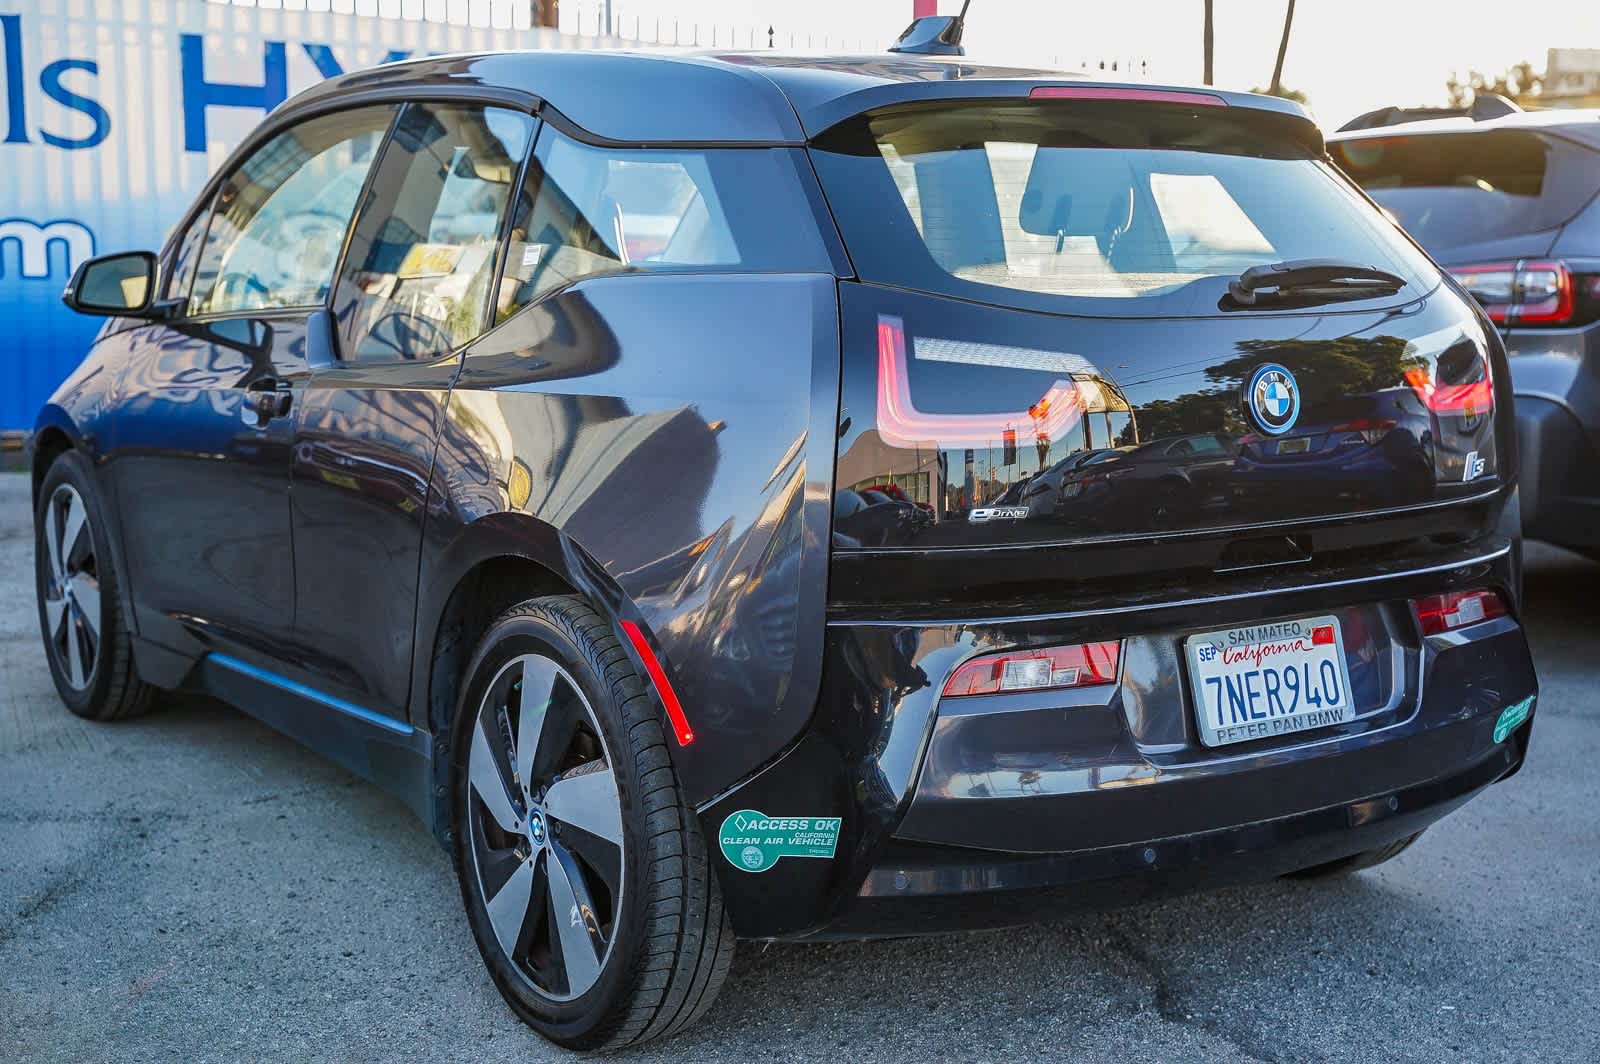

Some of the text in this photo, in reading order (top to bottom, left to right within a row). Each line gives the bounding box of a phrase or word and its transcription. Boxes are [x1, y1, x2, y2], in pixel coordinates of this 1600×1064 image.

[1228, 629, 1254, 645] SAN
[1257, 622, 1301, 643] MATEO
[1199, 646, 1217, 662] SEP
[1222, 639, 1314, 668] California
[1205, 659, 1340, 726] 7NER940
[1216, 708, 1344, 743] PETER PAN BMW
[747, 819, 836, 831] ACCESS OK
[722, 837, 833, 846] CLEAN AIR VEHICLE
